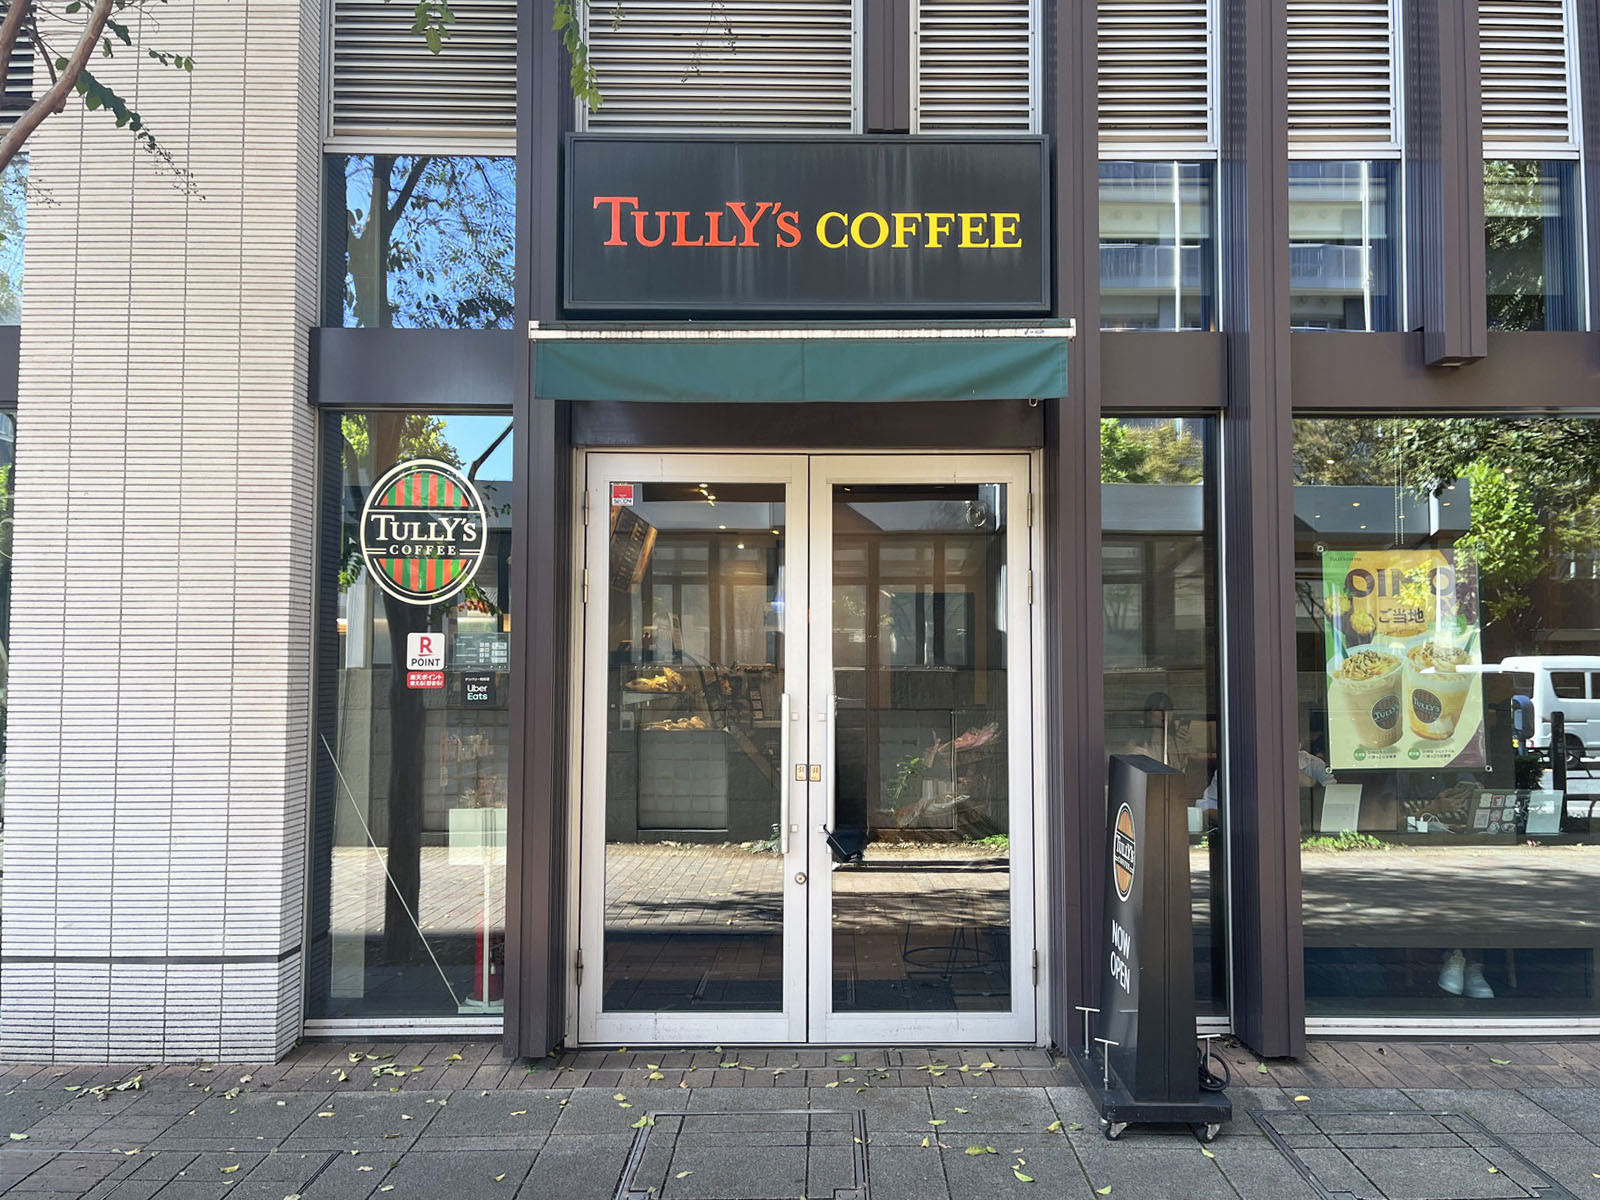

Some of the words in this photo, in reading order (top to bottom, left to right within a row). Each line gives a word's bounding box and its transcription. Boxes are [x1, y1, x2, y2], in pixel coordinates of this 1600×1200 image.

[593, 197, 802, 247] TULLY'S
[816, 212, 1022, 248] COFFEE
[371, 515, 477, 541] TULLY'S
[389, 545, 456, 555] COFFEE
[1379, 608, 1425, 623] ご当地
[420, 637, 432, 653] R
[411, 658, 440, 666] POINT
[467, 684, 487, 692] Uber
[467, 692, 487, 700] Eats
[1112, 920, 1130, 959] NOW
[1111, 951, 1130, 994] OPEN
